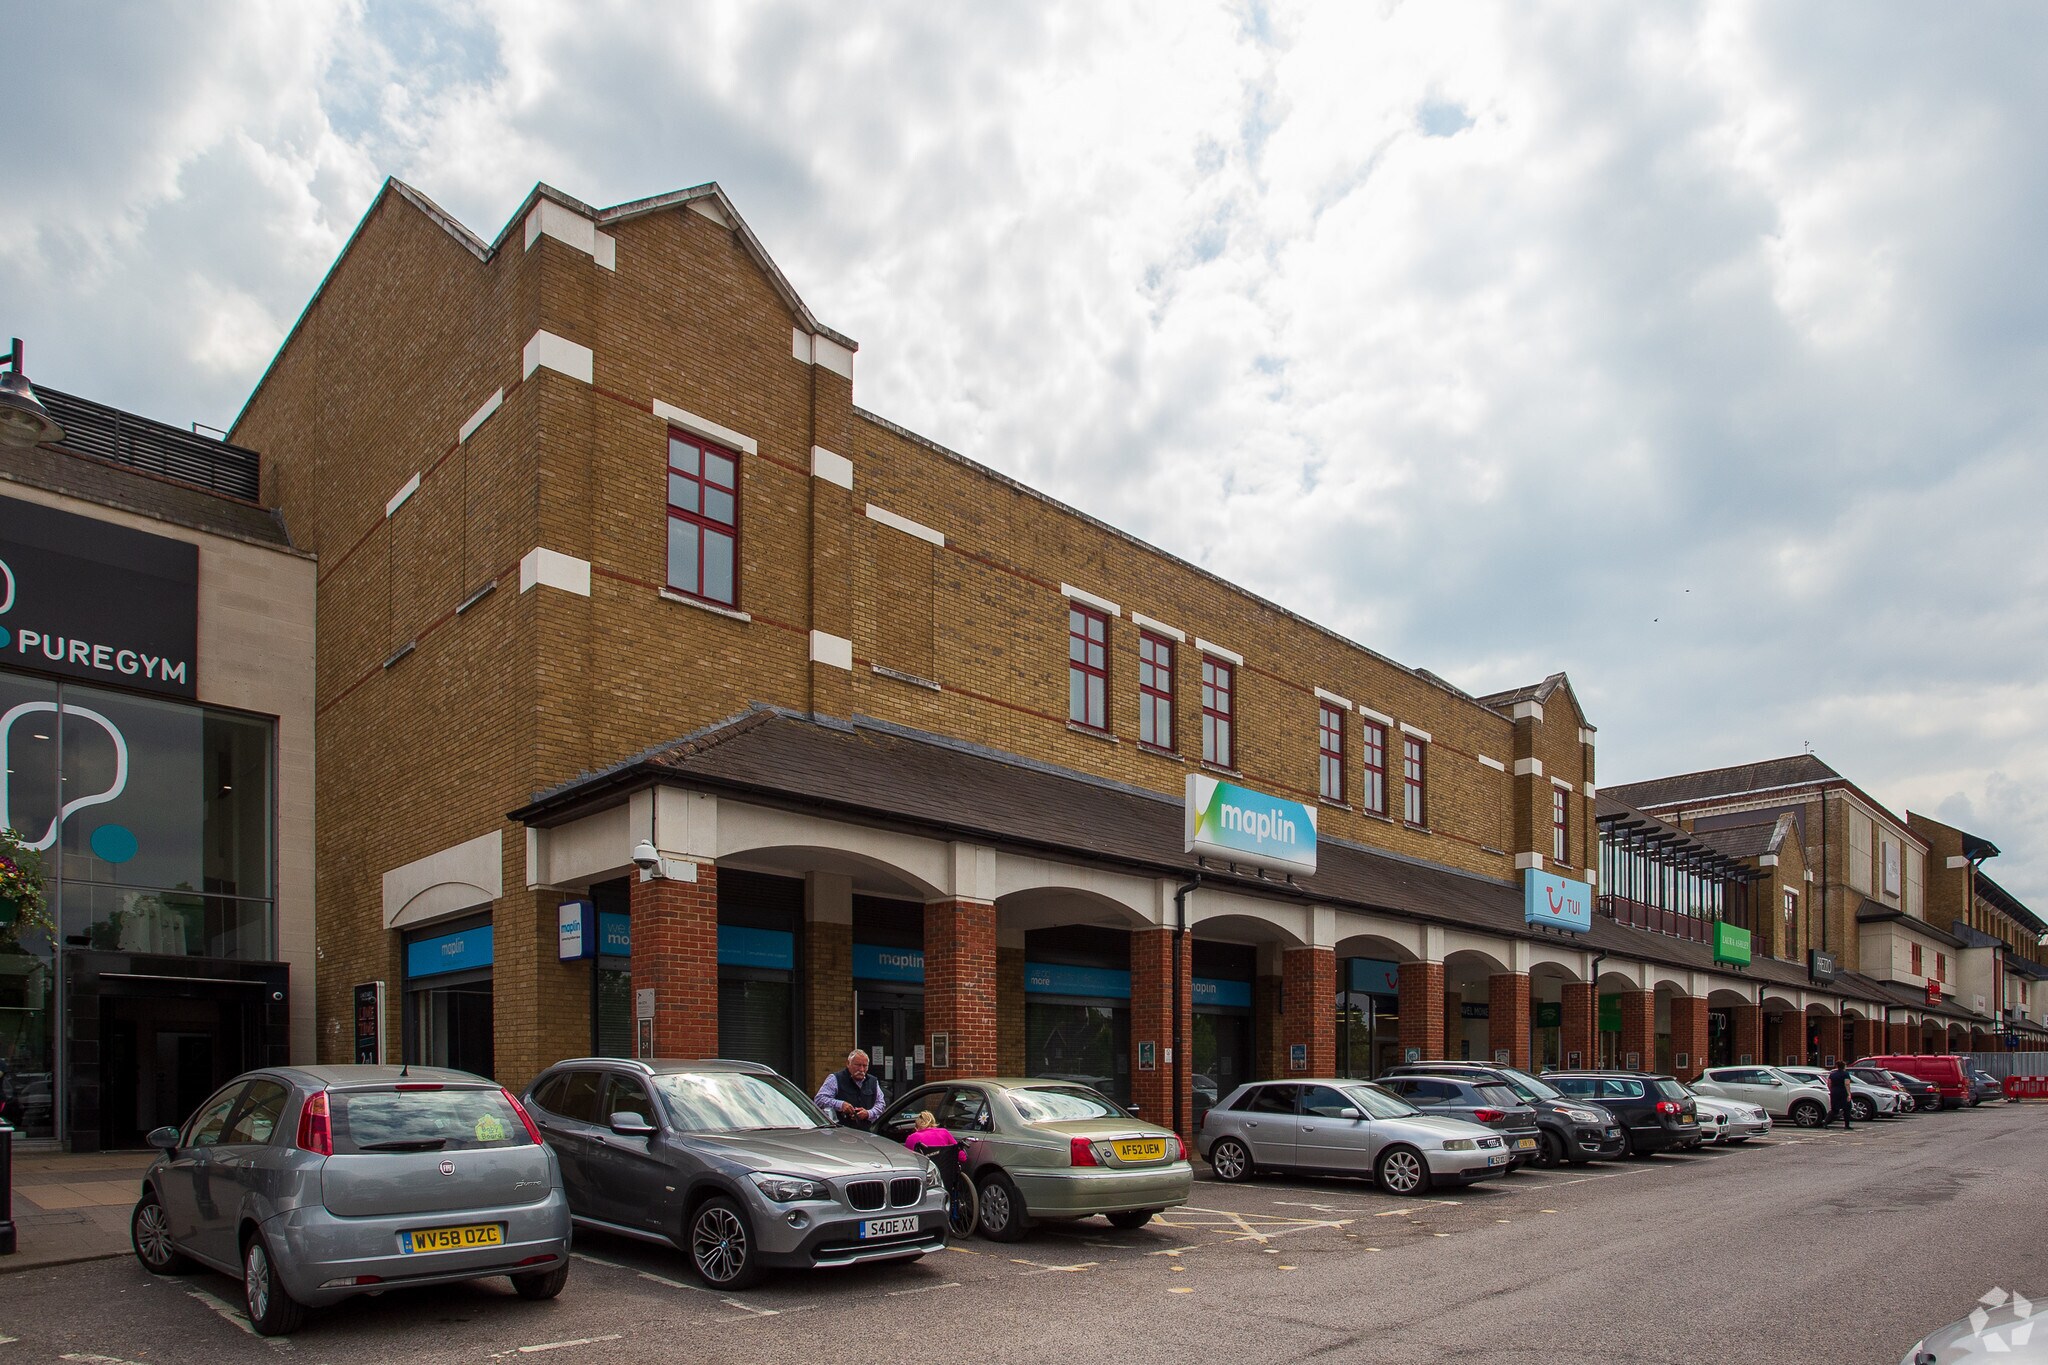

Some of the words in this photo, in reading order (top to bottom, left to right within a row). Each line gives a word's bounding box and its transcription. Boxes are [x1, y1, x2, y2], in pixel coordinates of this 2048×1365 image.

[18, 629, 186, 685] PUREGYM
[1221, 803, 1296, 844] maplin
[1567, 898, 1580, 916] TUI
[561, 920, 581, 935] maplin
[442, 937, 464, 958] maplin
[1722, 936, 1735, 946] LAURA
[1736, 939, 1749, 950] ASHLEY
[879, 953, 924, 970] maplin
[1817, 956, 1832, 974] PREZZO
[1031, 977, 1050, 986] more
[1122, 1144, 1143, 1155] AF52
[1144, 1143, 1160, 1154] UEM
[871, 1220, 899, 1235] S4DE
[902, 1218, 915, 1231] XX
[415, 1231, 460, 1249] WV58
[465, 1227, 498, 1244] OZC
